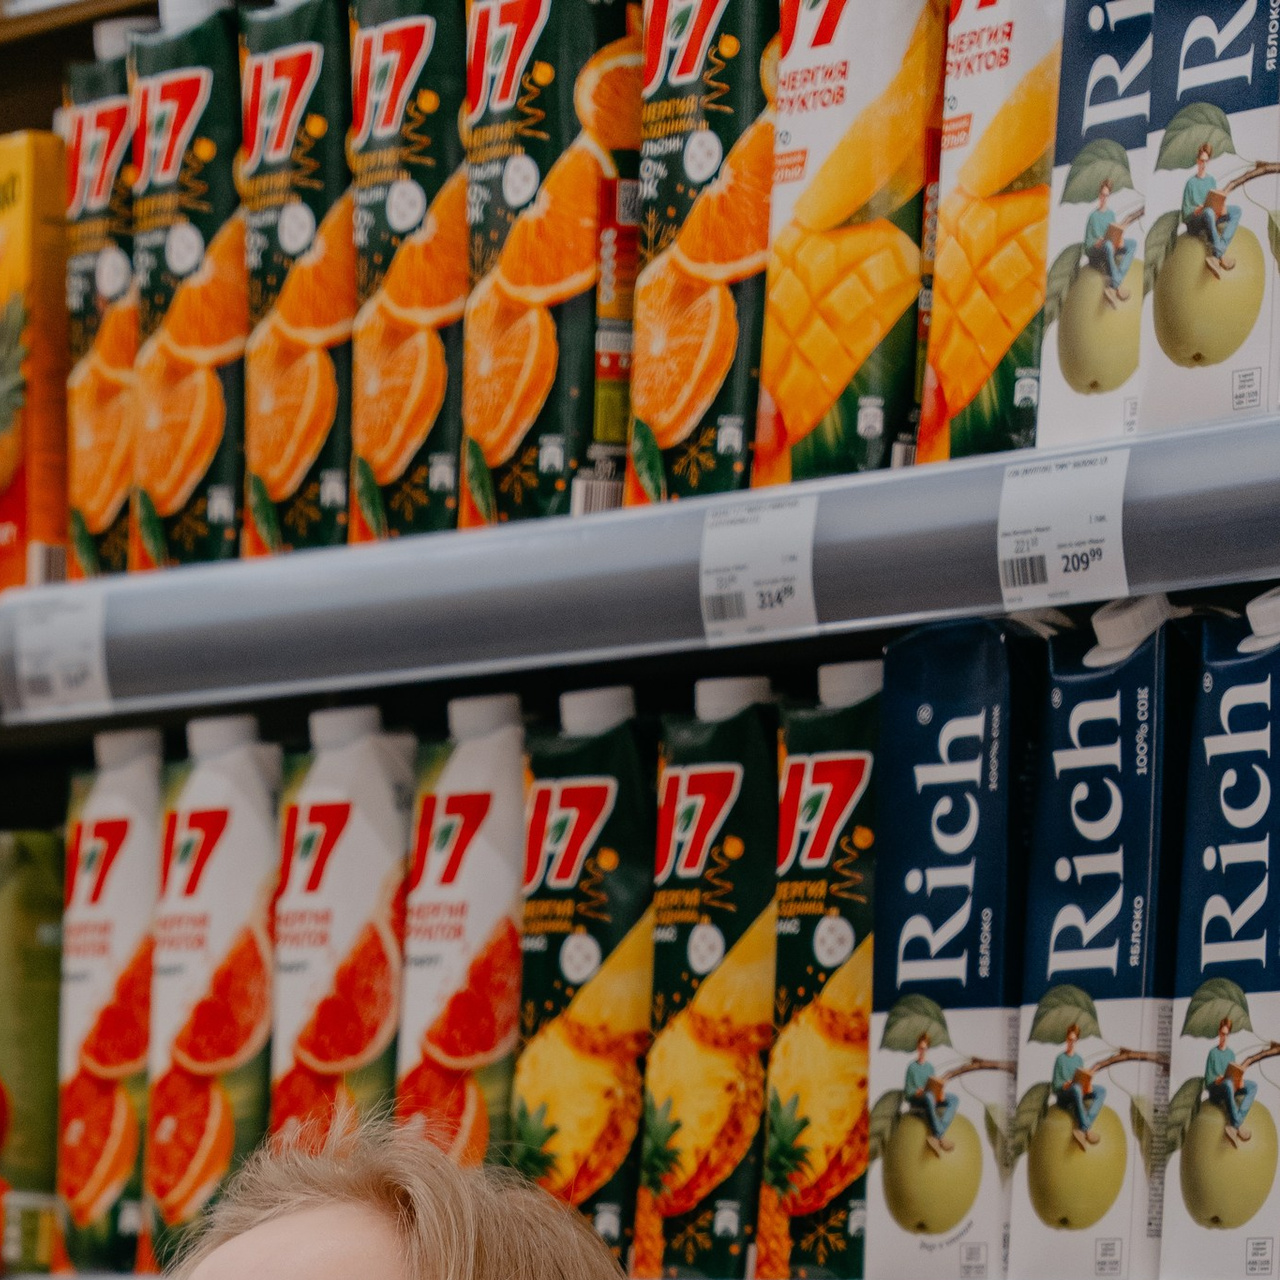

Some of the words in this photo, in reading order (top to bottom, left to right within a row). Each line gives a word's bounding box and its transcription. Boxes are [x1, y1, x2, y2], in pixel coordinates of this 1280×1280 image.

[778, 60, 848, 91] НЕРГИЯ
[946, 47, 1010, 78] РУКТОВ
[947, 21, 1013, 54] НЕРГИЯ
[1081, 0, 1154, 136] Ri
[776, 85, 845, 114] РУКТОВ
[520, 775, 617, 898] J7
[654, 762, 744, 886] J7
[776, 750, 873, 877] J7
[896, 706, 986, 990] Rich
[1047, 689, 1124, 981] Rich
[1200, 673, 1271, 973] Rich
[978, 907, 993, 978] ЯБЛОКО
[1129, 895, 1144, 967] ЯБЛОКО
